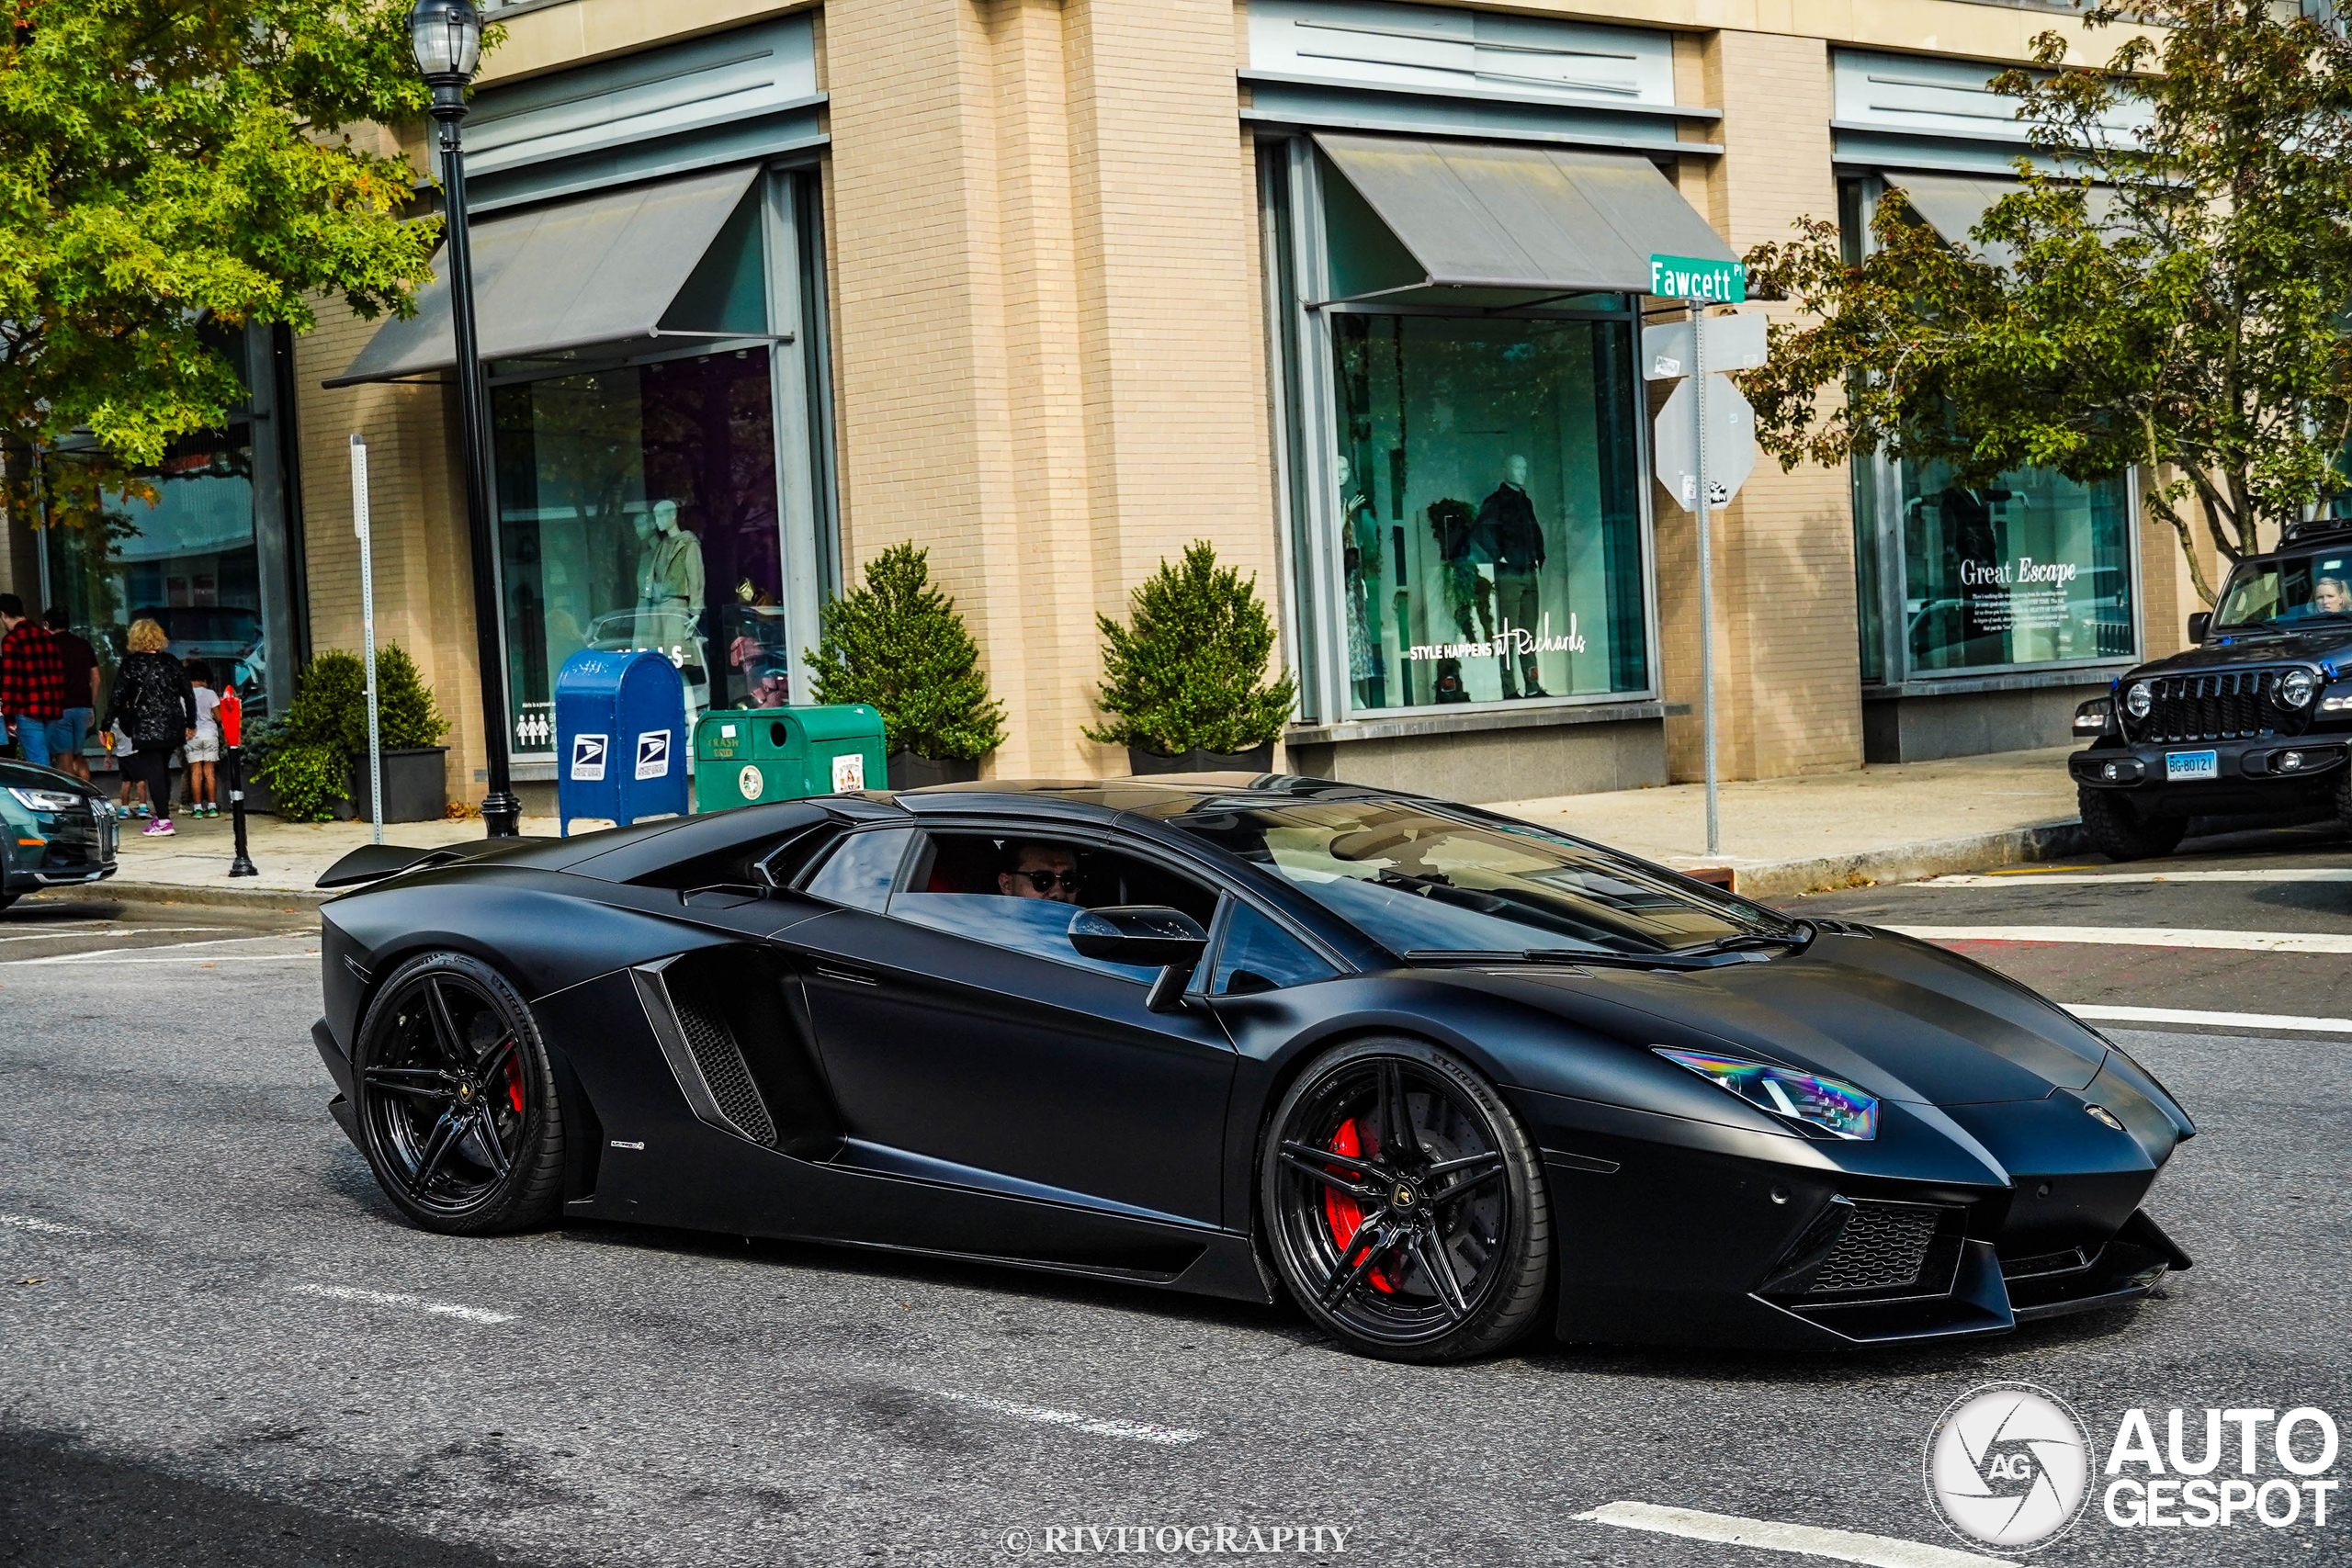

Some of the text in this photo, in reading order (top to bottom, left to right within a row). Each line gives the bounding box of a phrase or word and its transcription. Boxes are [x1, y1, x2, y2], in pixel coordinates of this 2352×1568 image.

[1651, 261, 1731, 301] Fawcett
[1961, 557, 2076, 588] Great Escape
[1409, 612, 1586, 671] STYLE HAPPENS at Richards
